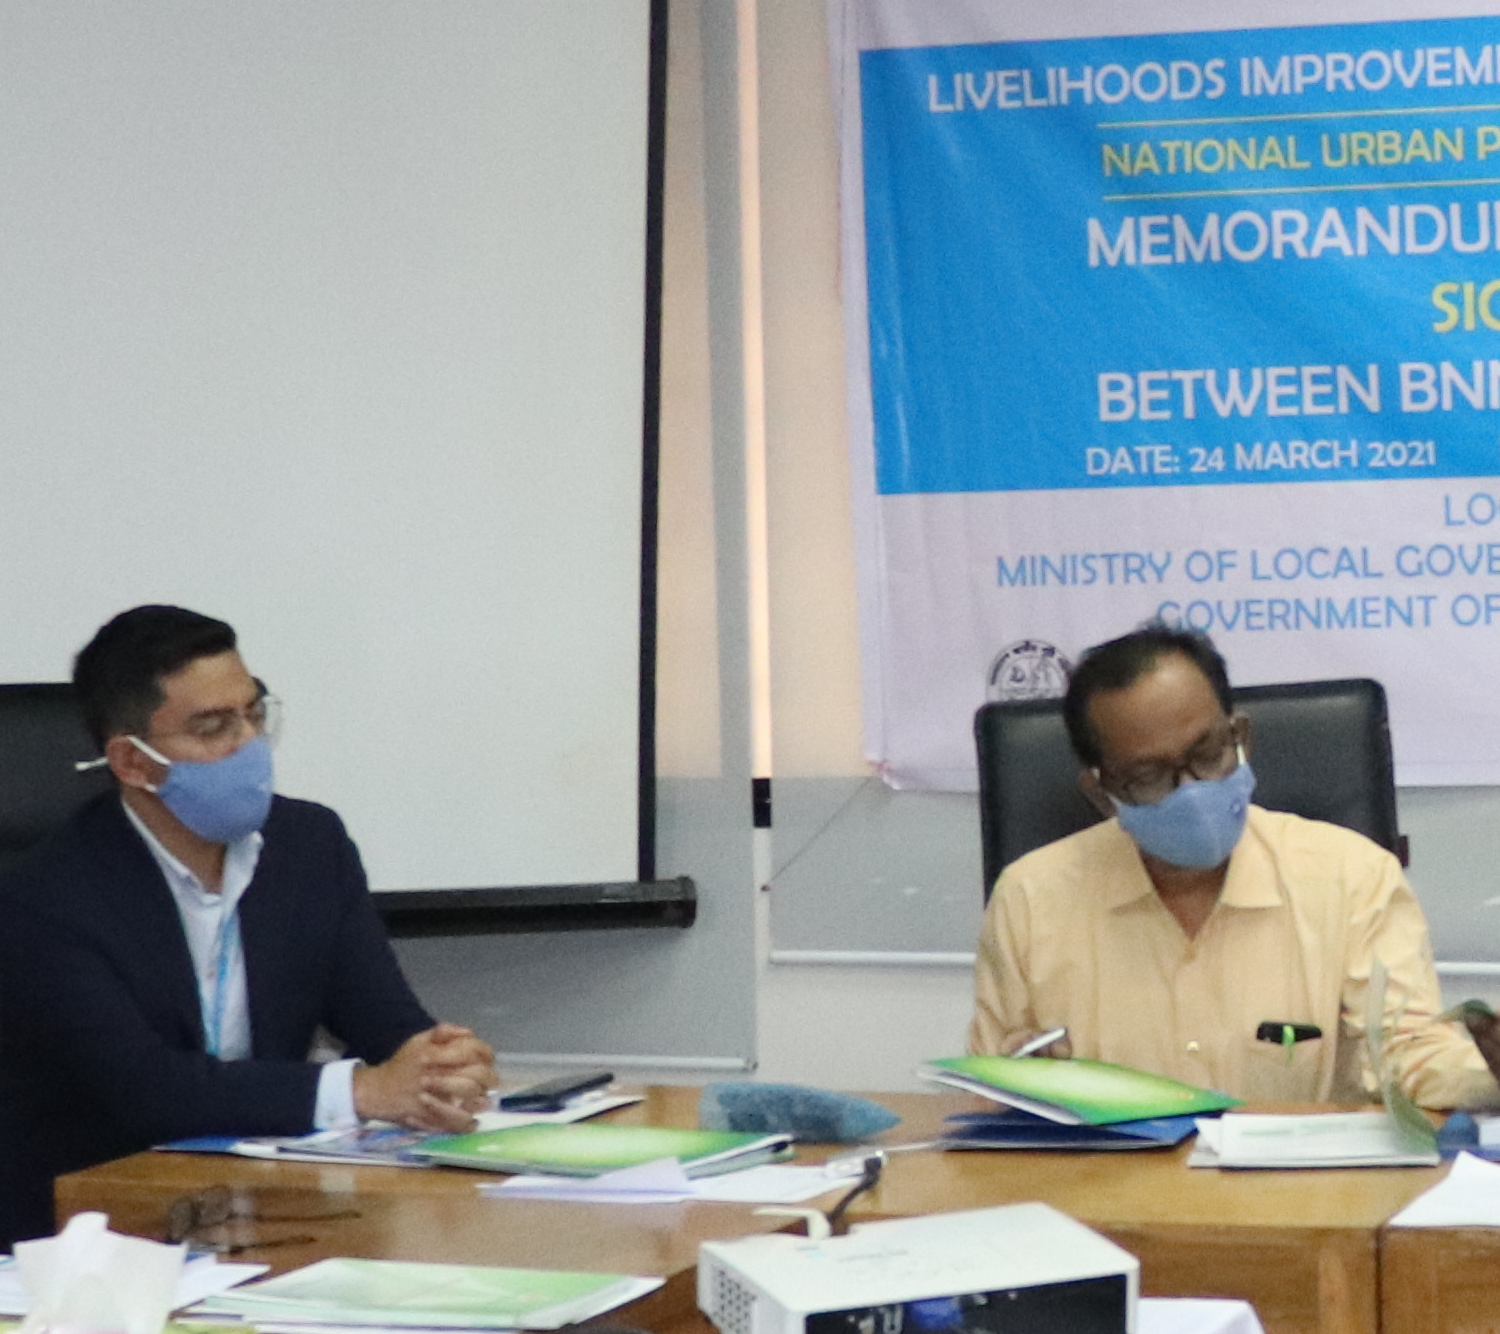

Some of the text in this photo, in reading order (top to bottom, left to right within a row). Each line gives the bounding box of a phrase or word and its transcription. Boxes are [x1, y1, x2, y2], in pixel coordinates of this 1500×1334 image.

[927, 58, 1226, 113] LIVELIHOODS
[1101, 134, 1311, 176] NATIONAL
[1320, 126, 1464, 167] URBAN
[1097, 364, 1382, 423] BETWEEN
[1086, 444, 1181, 475] DATE:
[1188, 445, 1225, 472] 24
[1234, 439, 1359, 470] MARCH
[1367, 439, 1437, 467] 2021
[996, 551, 1173, 587] MINISTRY
[1184, 549, 1238, 583] OF
[1250, 546, 1384, 581] LOCAL
[1156, 595, 1438, 633] GOVERNMENT
